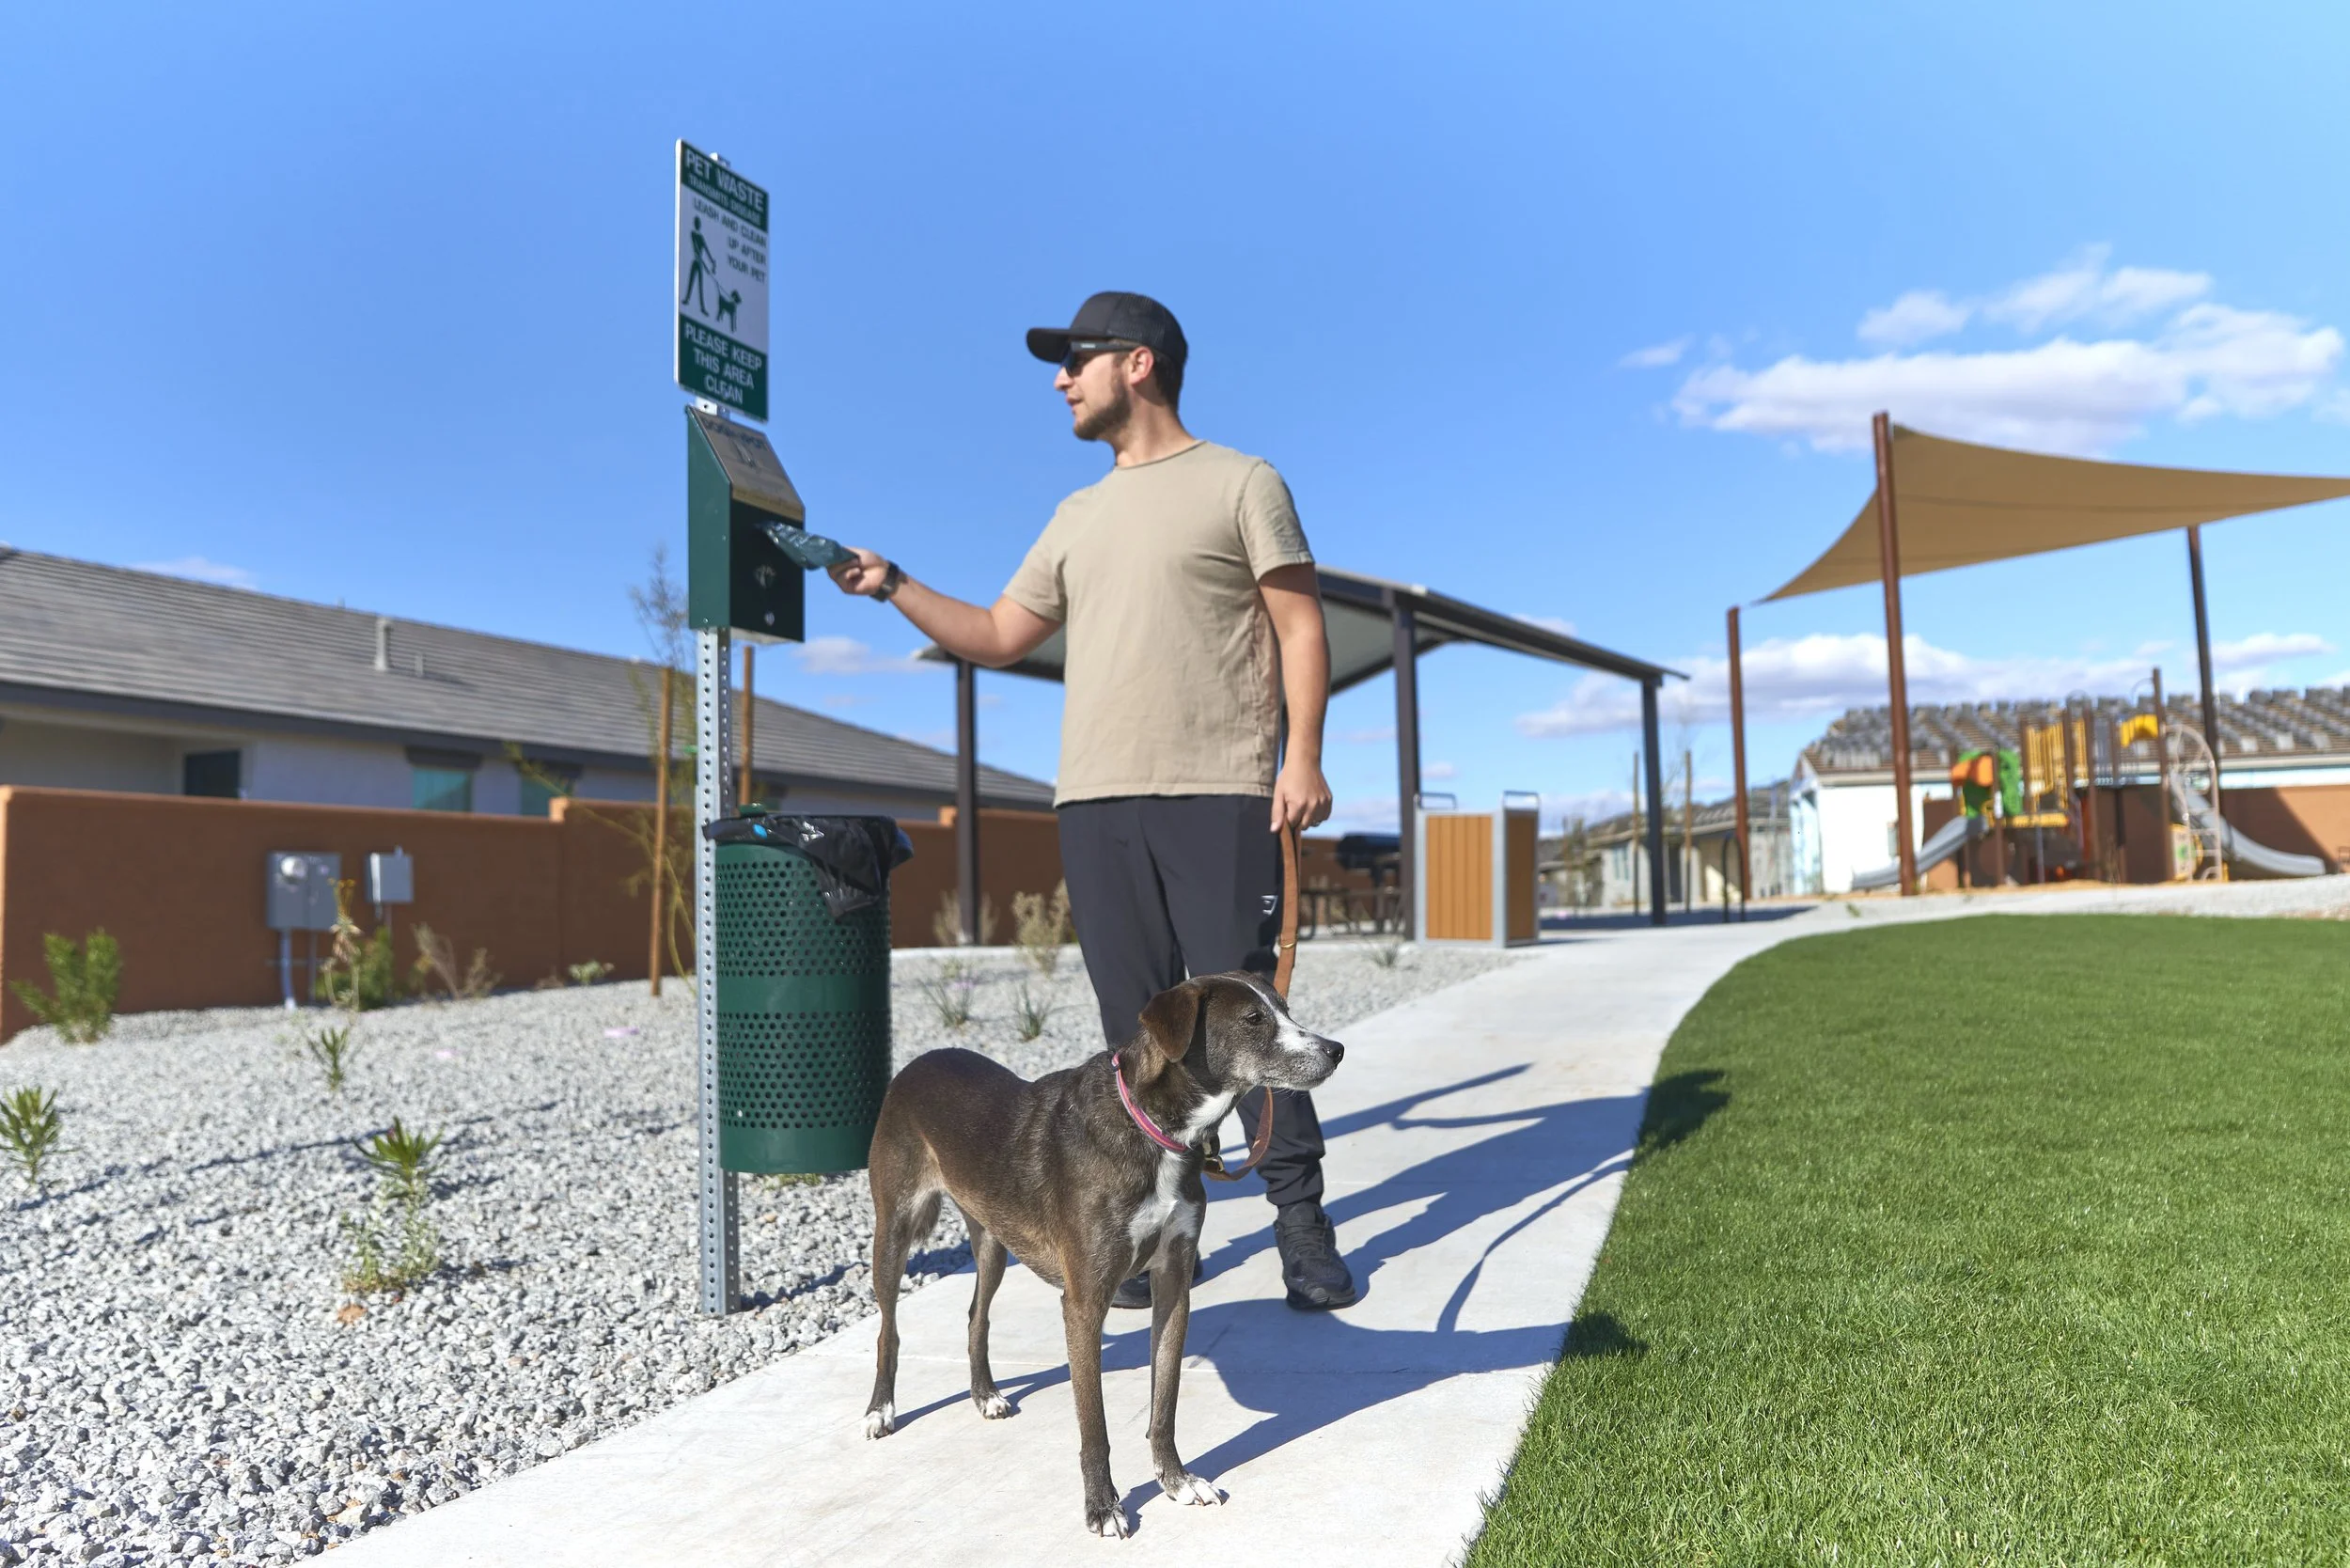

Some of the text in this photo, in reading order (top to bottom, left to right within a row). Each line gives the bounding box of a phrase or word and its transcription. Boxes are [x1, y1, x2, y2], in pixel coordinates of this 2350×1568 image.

[686, 149, 764, 212] PET WASTE
[694, 196, 767, 248] LEASH AND CLEAN
[728, 236, 766, 265] UP AFTER
[728, 254, 766, 285] YOUR PET
[684, 322, 762, 372] PLEASE KEEP
[694, 347, 754, 390] THIS AREA
[705, 373, 744, 404] CLEAN
